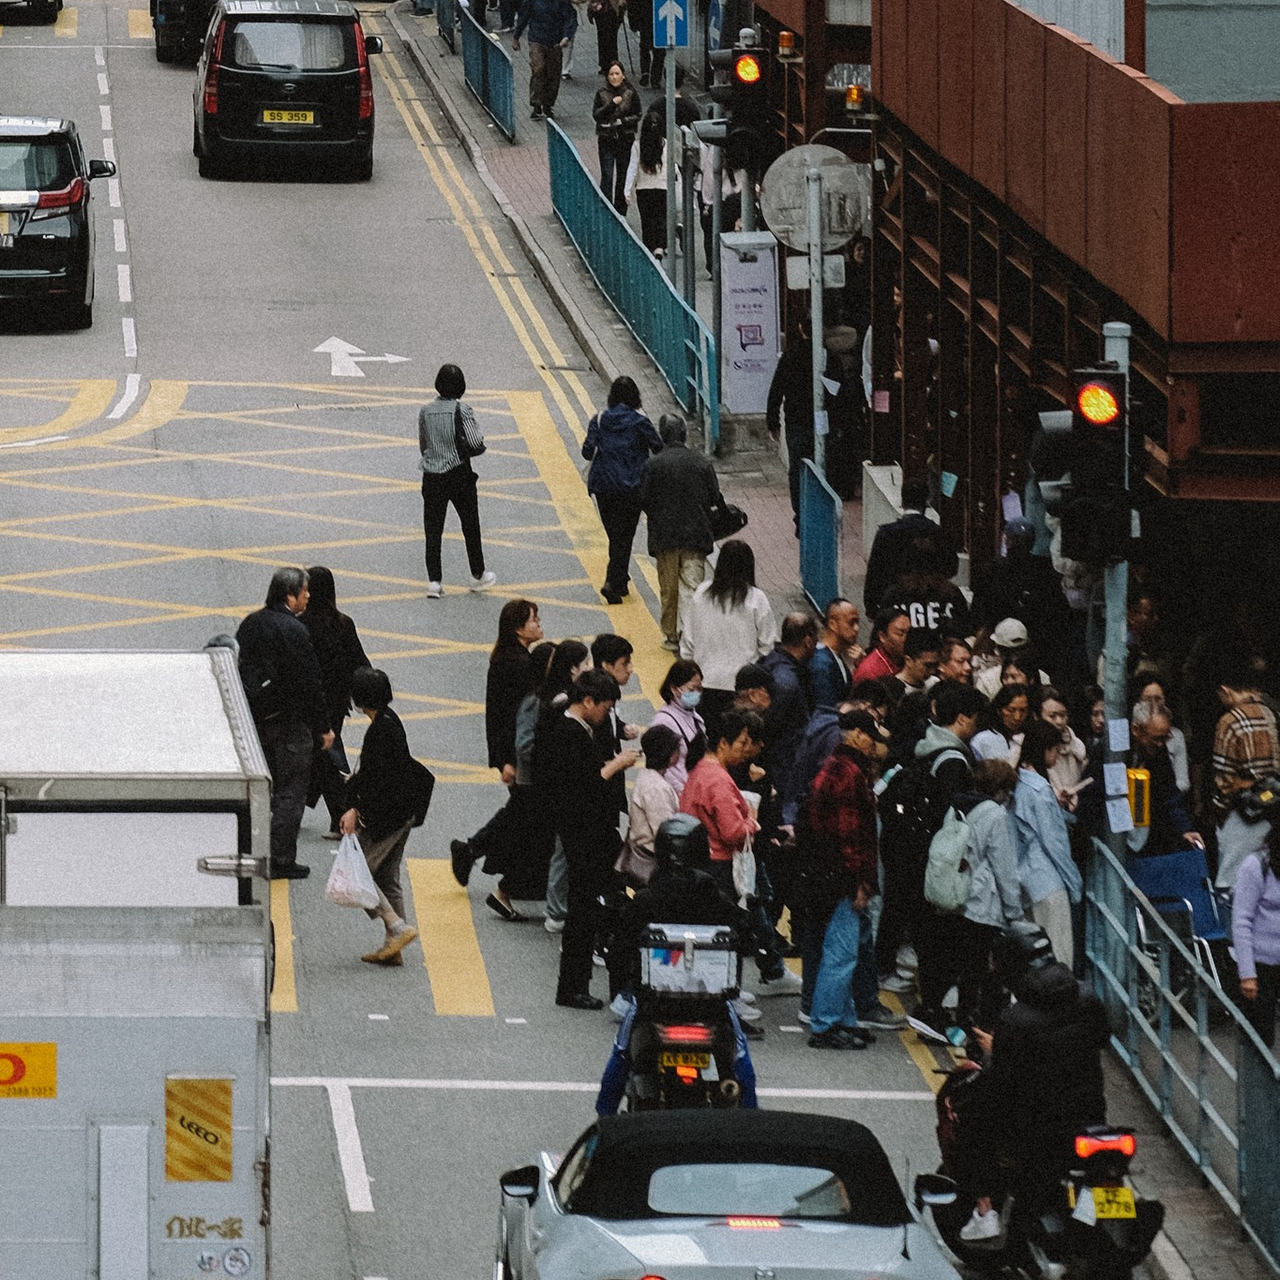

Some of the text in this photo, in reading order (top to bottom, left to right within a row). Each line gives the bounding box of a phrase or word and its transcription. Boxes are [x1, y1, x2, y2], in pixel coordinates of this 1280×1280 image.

[270, 112, 307, 121] SS 359
[179, 1114, 220, 1145] LEEO
